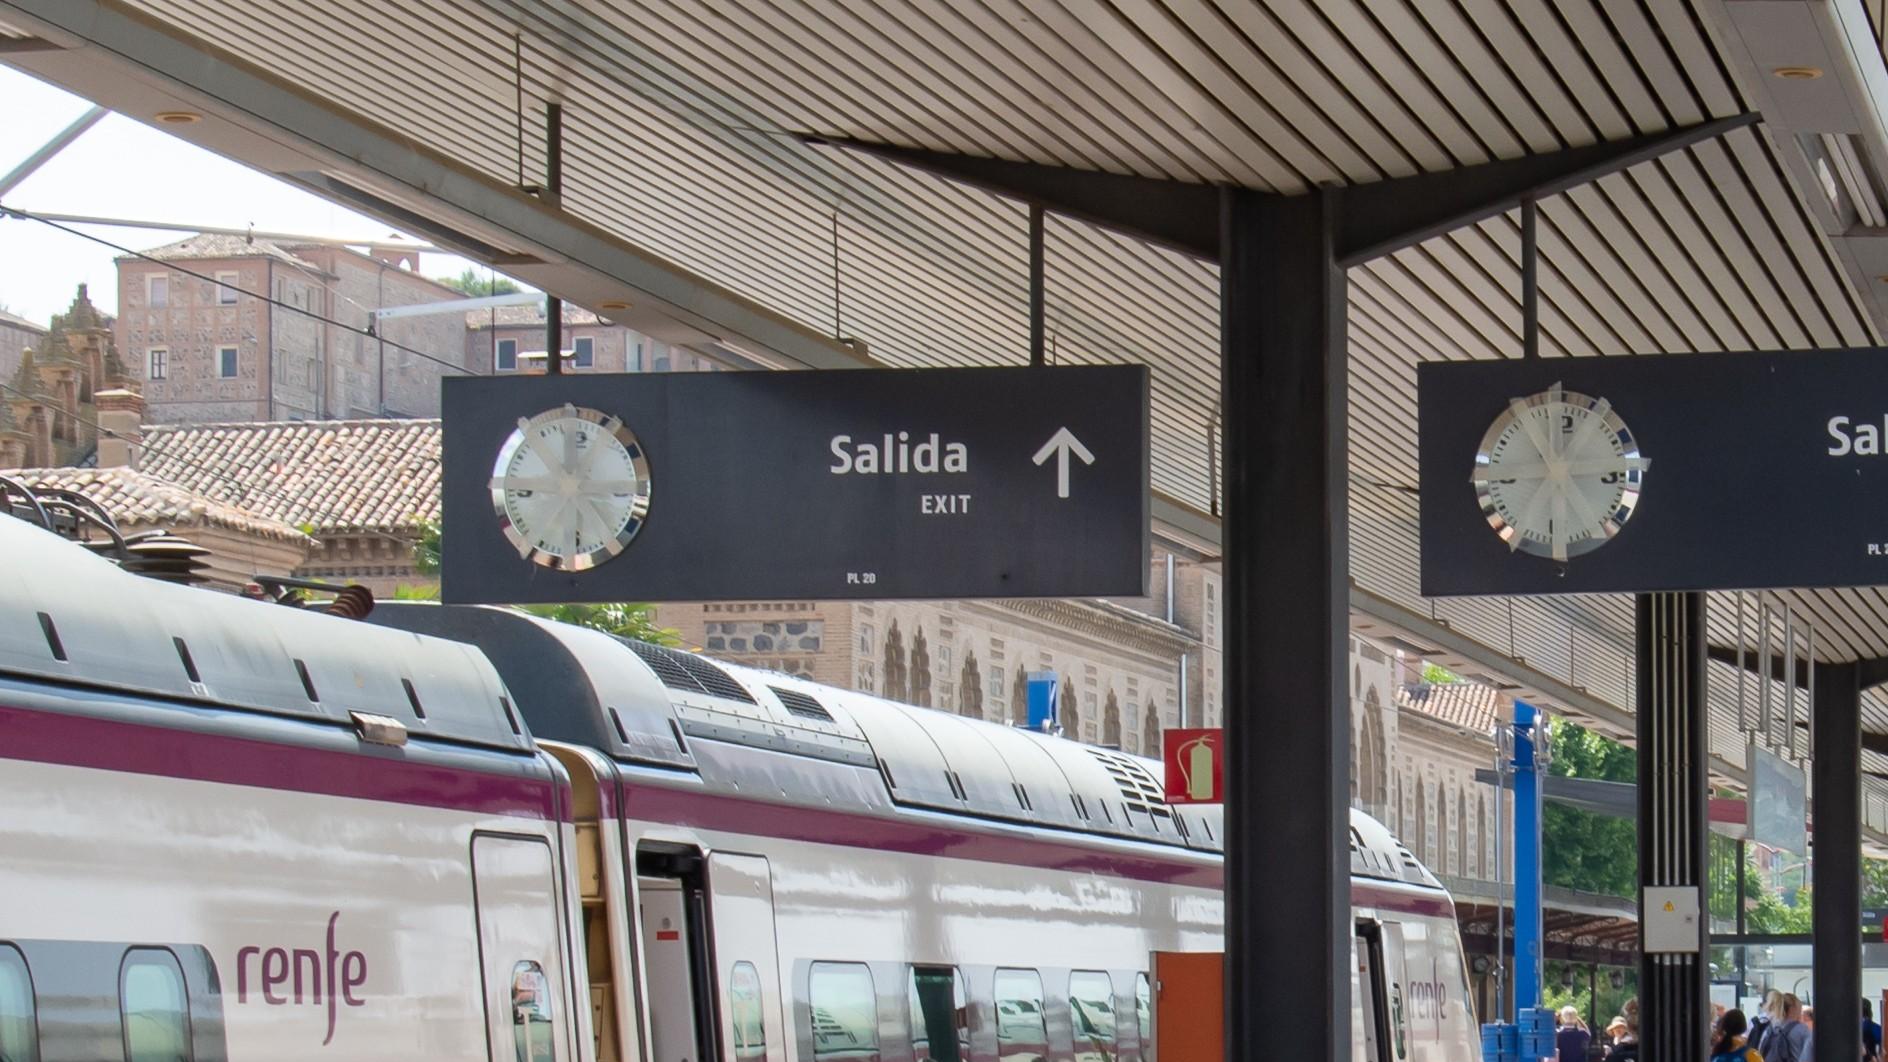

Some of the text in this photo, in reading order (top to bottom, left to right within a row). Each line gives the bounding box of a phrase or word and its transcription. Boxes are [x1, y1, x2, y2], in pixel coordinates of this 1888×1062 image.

[830, 431, 968, 474] Salida
[921, 494, 972, 514] EXIT
[1868, 543, 1882, 556] PL
[847, 572, 876, 585] PL 20
[236, 910, 368, 1047] renfe
[1410, 957, 1447, 1045] renfe
